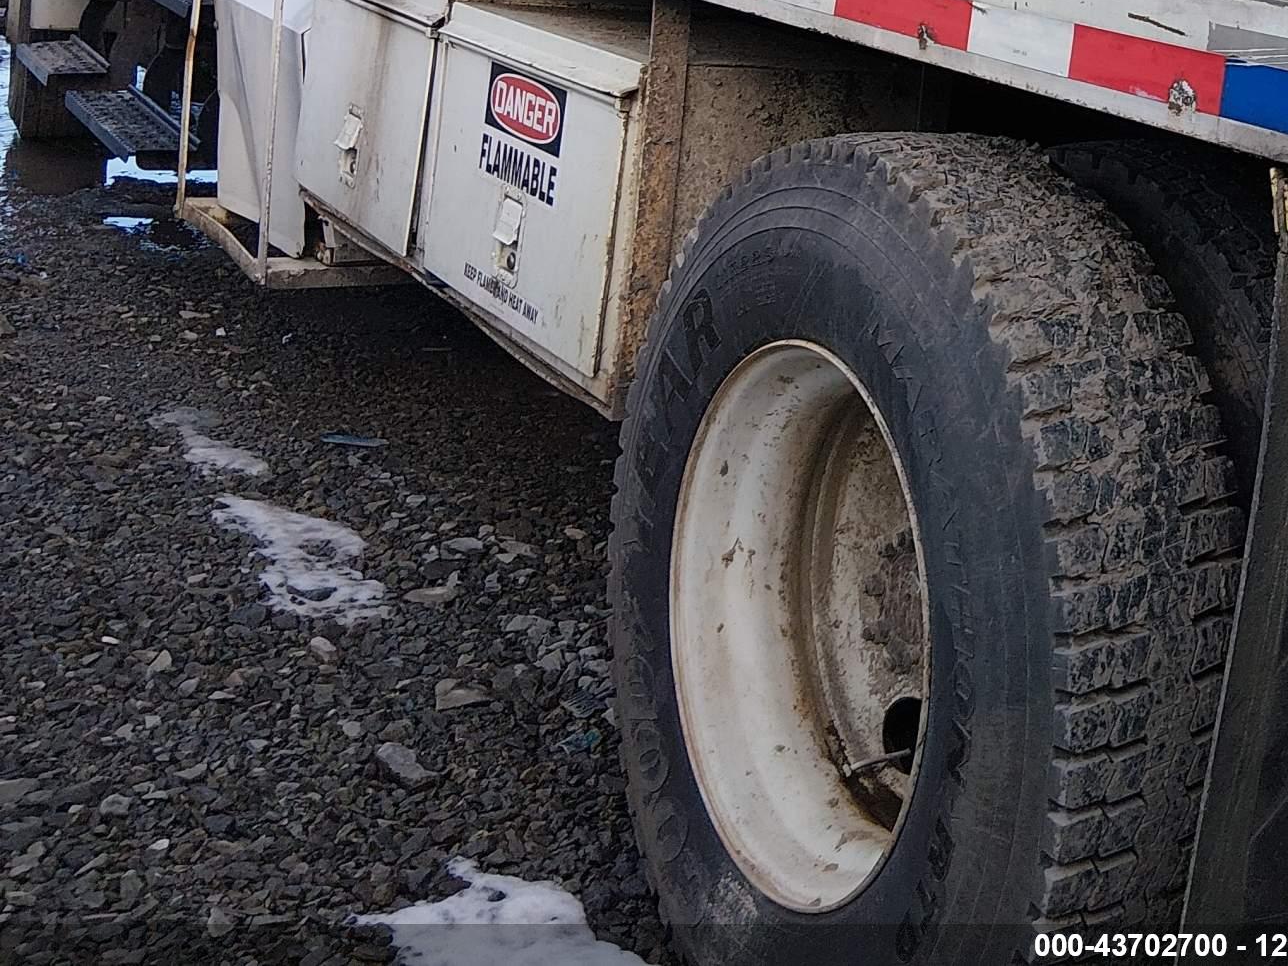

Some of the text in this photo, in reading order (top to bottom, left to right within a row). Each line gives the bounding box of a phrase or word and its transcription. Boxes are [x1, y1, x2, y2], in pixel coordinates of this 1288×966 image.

[494, 80, 557, 138] DANGER
[479, 133, 558, 207] FLAMMABLE
[464, 262, 478, 282] KEEP
[508, 291, 523, 313] HEAT
[522, 302, 539, 324] AWAY
